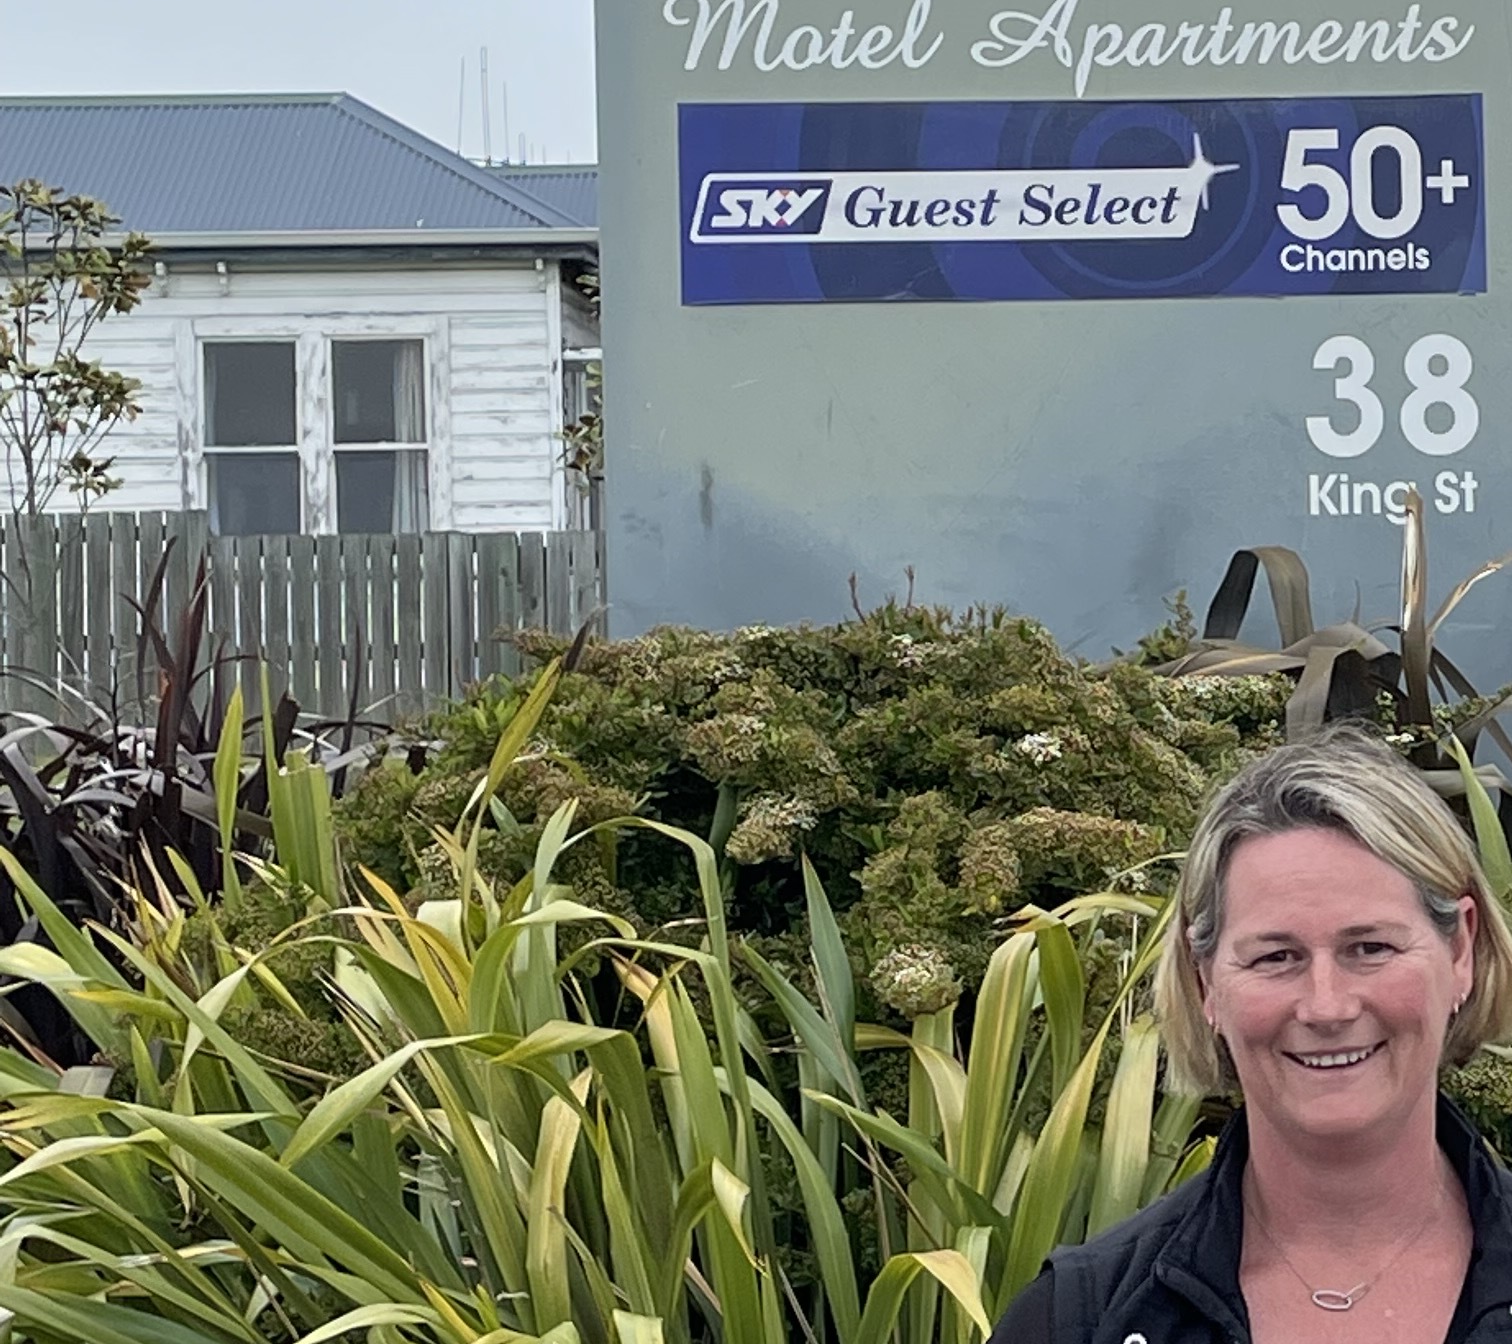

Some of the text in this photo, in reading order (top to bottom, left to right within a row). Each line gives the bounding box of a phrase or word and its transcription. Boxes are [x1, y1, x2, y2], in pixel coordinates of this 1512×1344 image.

[708, 182, 1182, 229] SKY Guest Select
[1276, 125, 1470, 241] 50+
[1279, 242, 1431, 272] Channels
[1306, 333, 1480, 457] 38
[1308, 471, 1478, 525] King St
